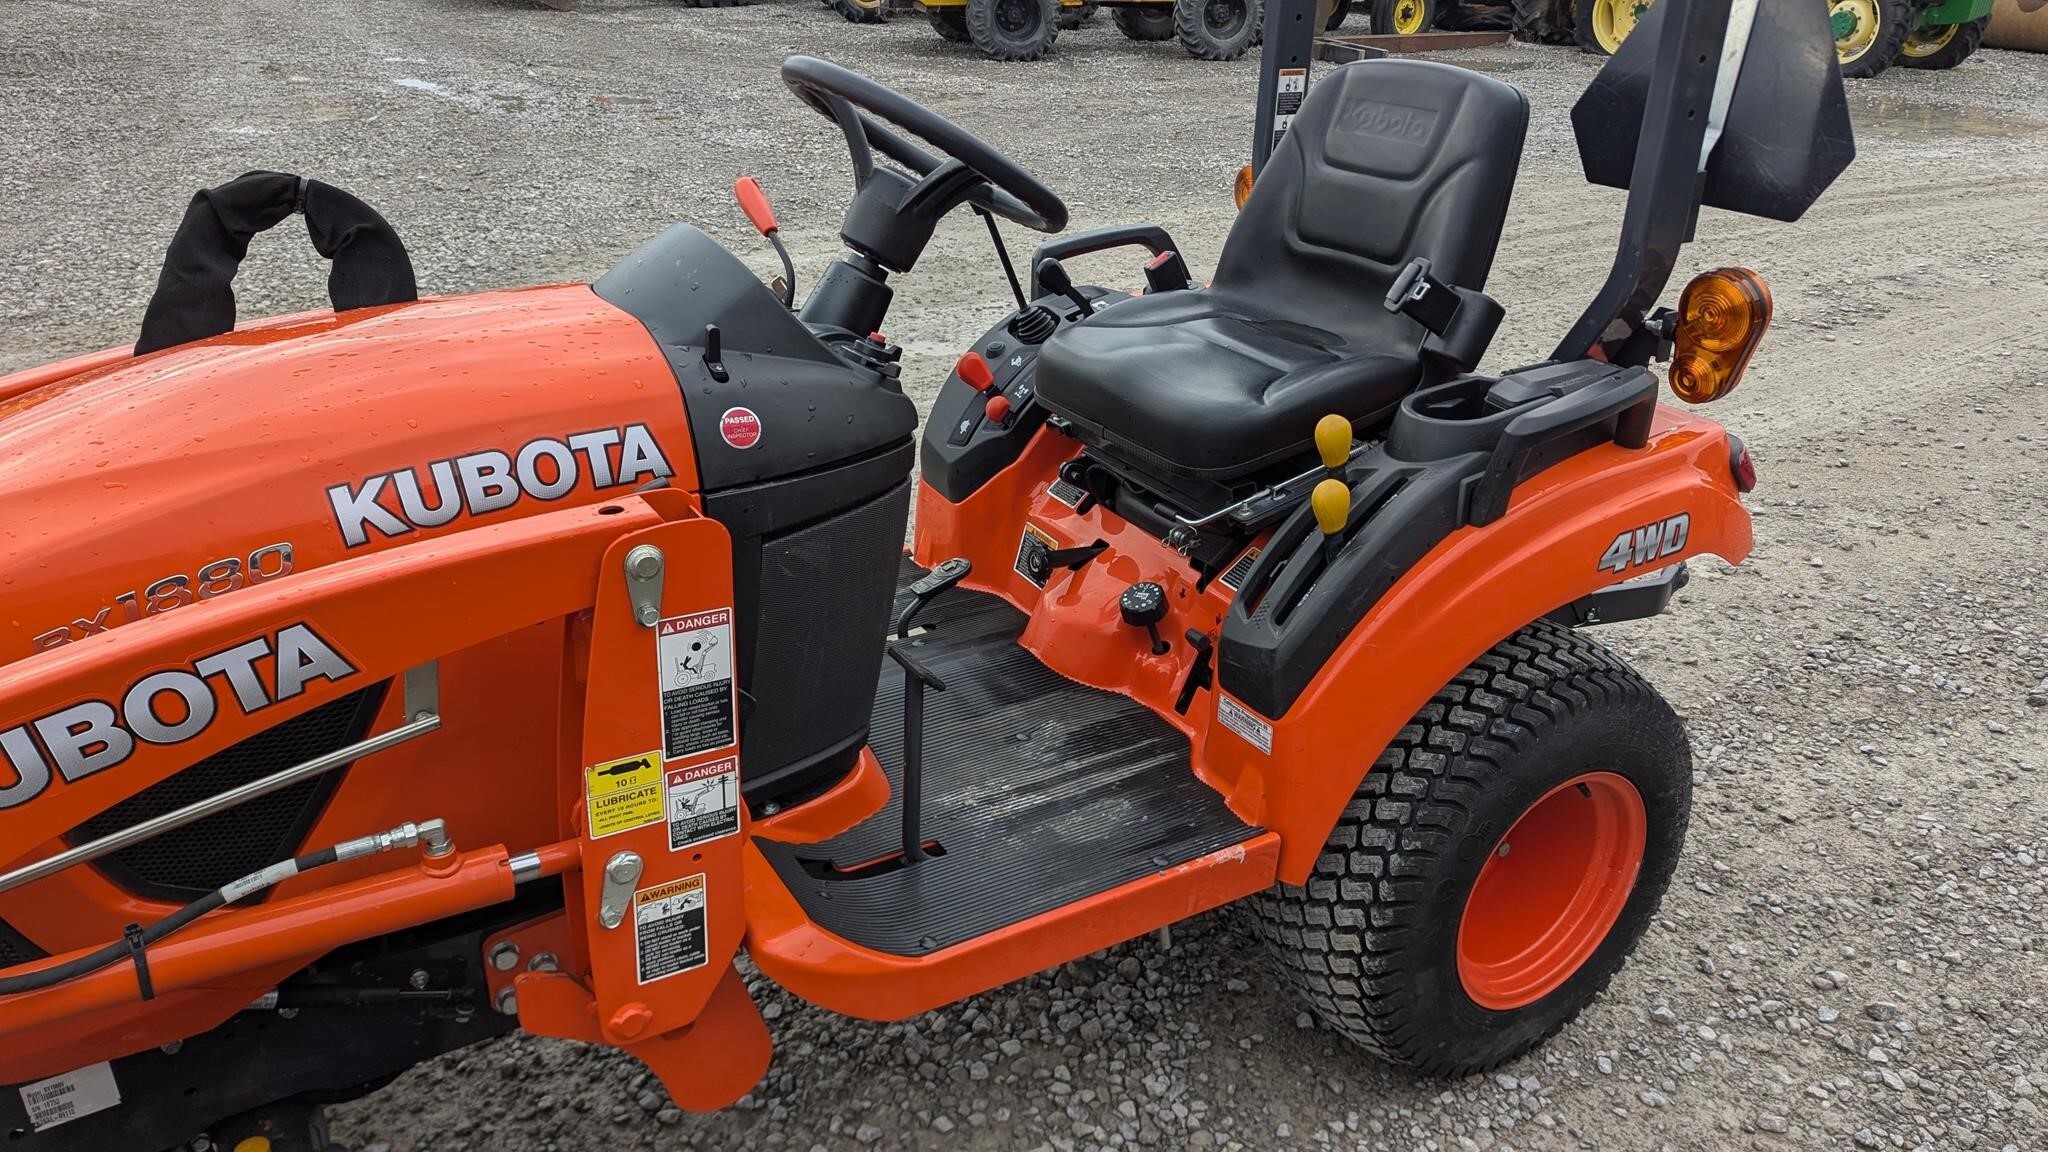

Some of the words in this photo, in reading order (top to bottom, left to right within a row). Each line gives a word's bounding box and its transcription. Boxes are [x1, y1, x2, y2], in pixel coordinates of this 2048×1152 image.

[724, 416, 755, 424] PASSED
[325, 422, 676, 547] KUBOTA
[1597, 512, 1690, 574] 4WD
[676, 612, 727, 630] DANGER
[688, 683, 712, 692] SERIOUS
[713, 679, 729, 687] INJURY
[674, 693, 693, 702] DEATH
[695, 688, 718, 697] CAUSED
[664, 701, 687, 710] FALLING
[685, 761, 732, 780] DANGER
[616, 778, 627, 787] 10
[596, 787, 656, 807] LUBRICATE
[596, 808, 615, 816] EVERY
[626, 800, 646, 809] HOURS
[681, 822, 697, 830] DEATH
[699, 816, 718, 825] CAUSED
[696, 812, 717, 821] SERIOUS
[673, 827, 695, 837] CONTACT
[711, 816, 734, 826] ELECTRIC
[650, 878, 699, 899] WARNING
[648, 920, 663, 928] AVOID
[665, 914, 684, 923] INJURY
[656, 922, 672, 930] FALLS
[640, 932, 656, 941] BEING
